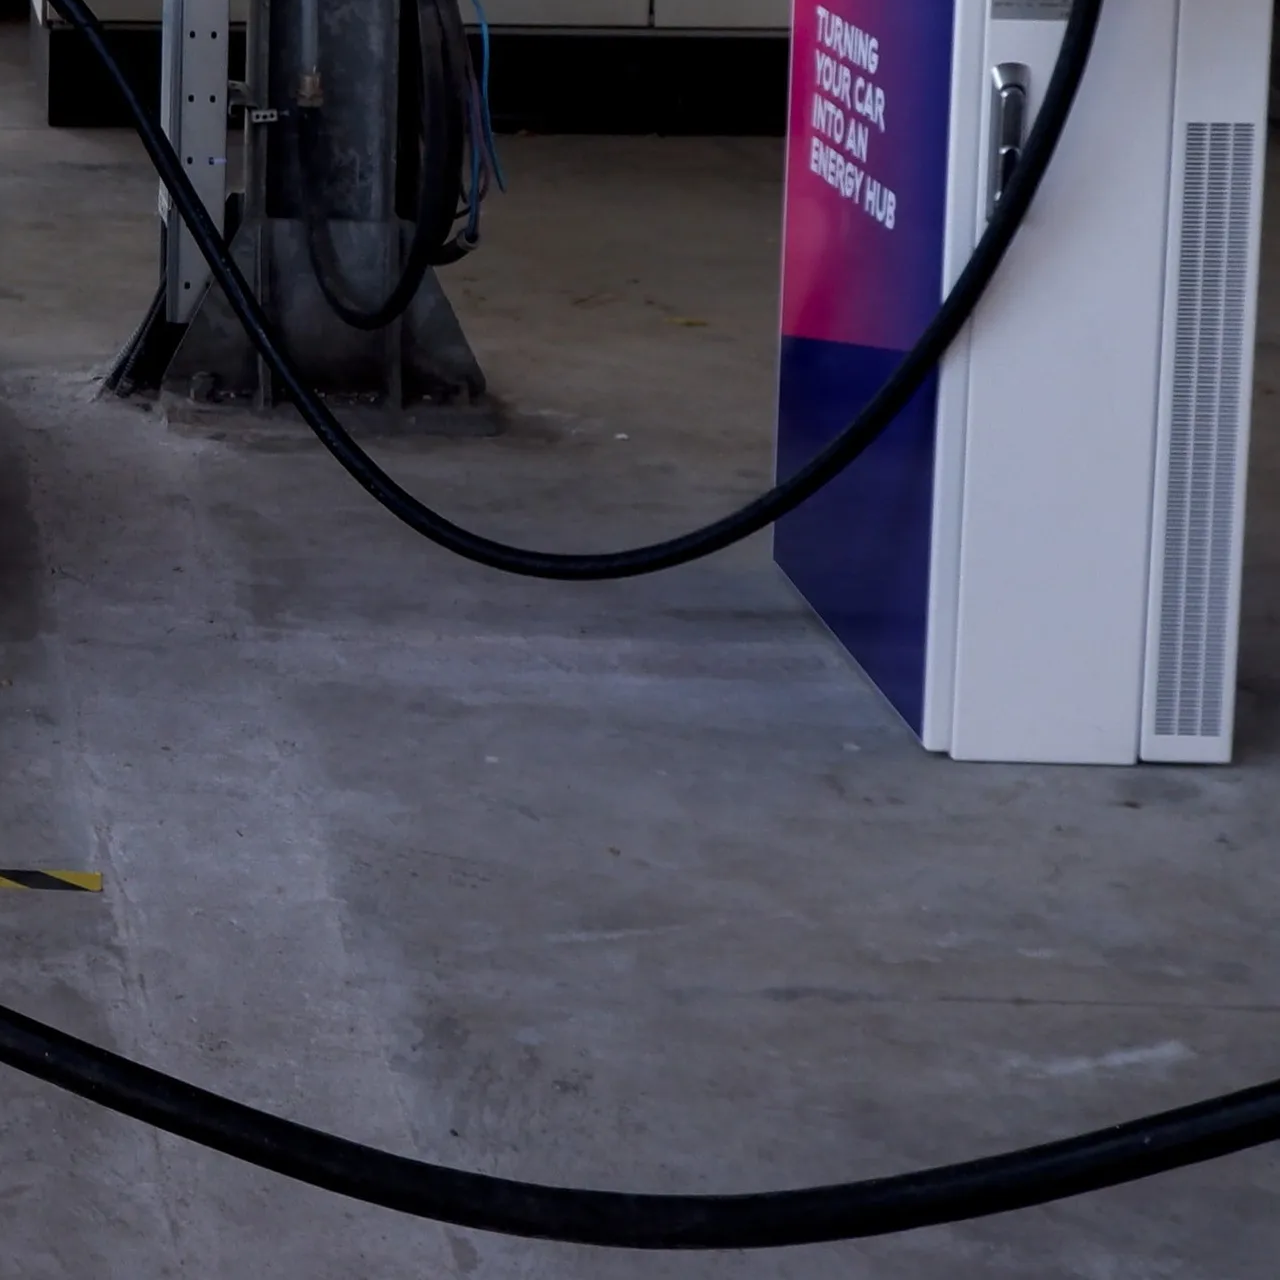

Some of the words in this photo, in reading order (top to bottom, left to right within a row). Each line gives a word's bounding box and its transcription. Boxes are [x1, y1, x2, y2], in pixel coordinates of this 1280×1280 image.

[817, 7, 878, 73] TURNING
[812, 93, 845, 145] INTO
[845, 118, 869, 163] AN
[814, 48, 852, 110] YOUR
[854, 76, 886, 133] CAR
[811, 137, 863, 204] ENERGY
[865, 177, 896, 229] HUB
